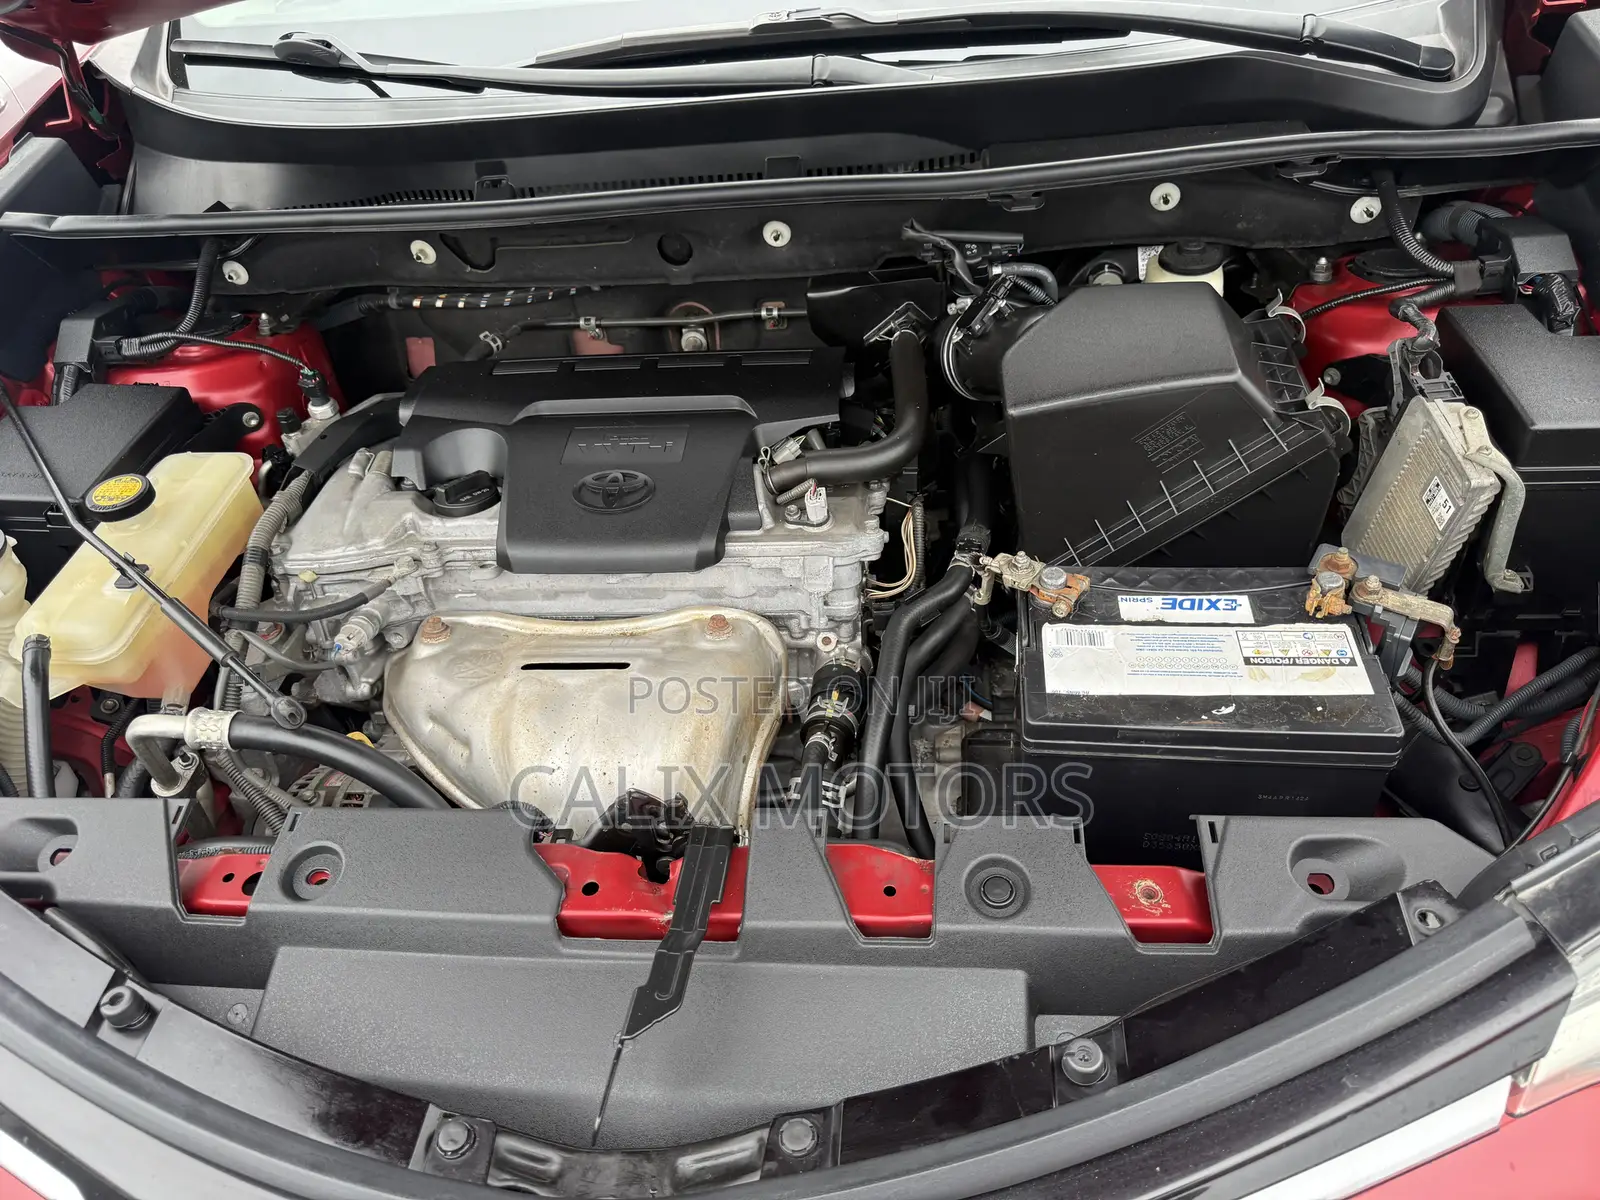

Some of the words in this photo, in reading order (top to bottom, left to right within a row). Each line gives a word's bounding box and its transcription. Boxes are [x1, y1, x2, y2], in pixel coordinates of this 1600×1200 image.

[1441, 498, 1452, 515] 51
[1117, 596, 1153, 604] SPRIN
[1160, 597, 1242, 612] EXIDE
[1295, 656, 1340, 665] DANGER
